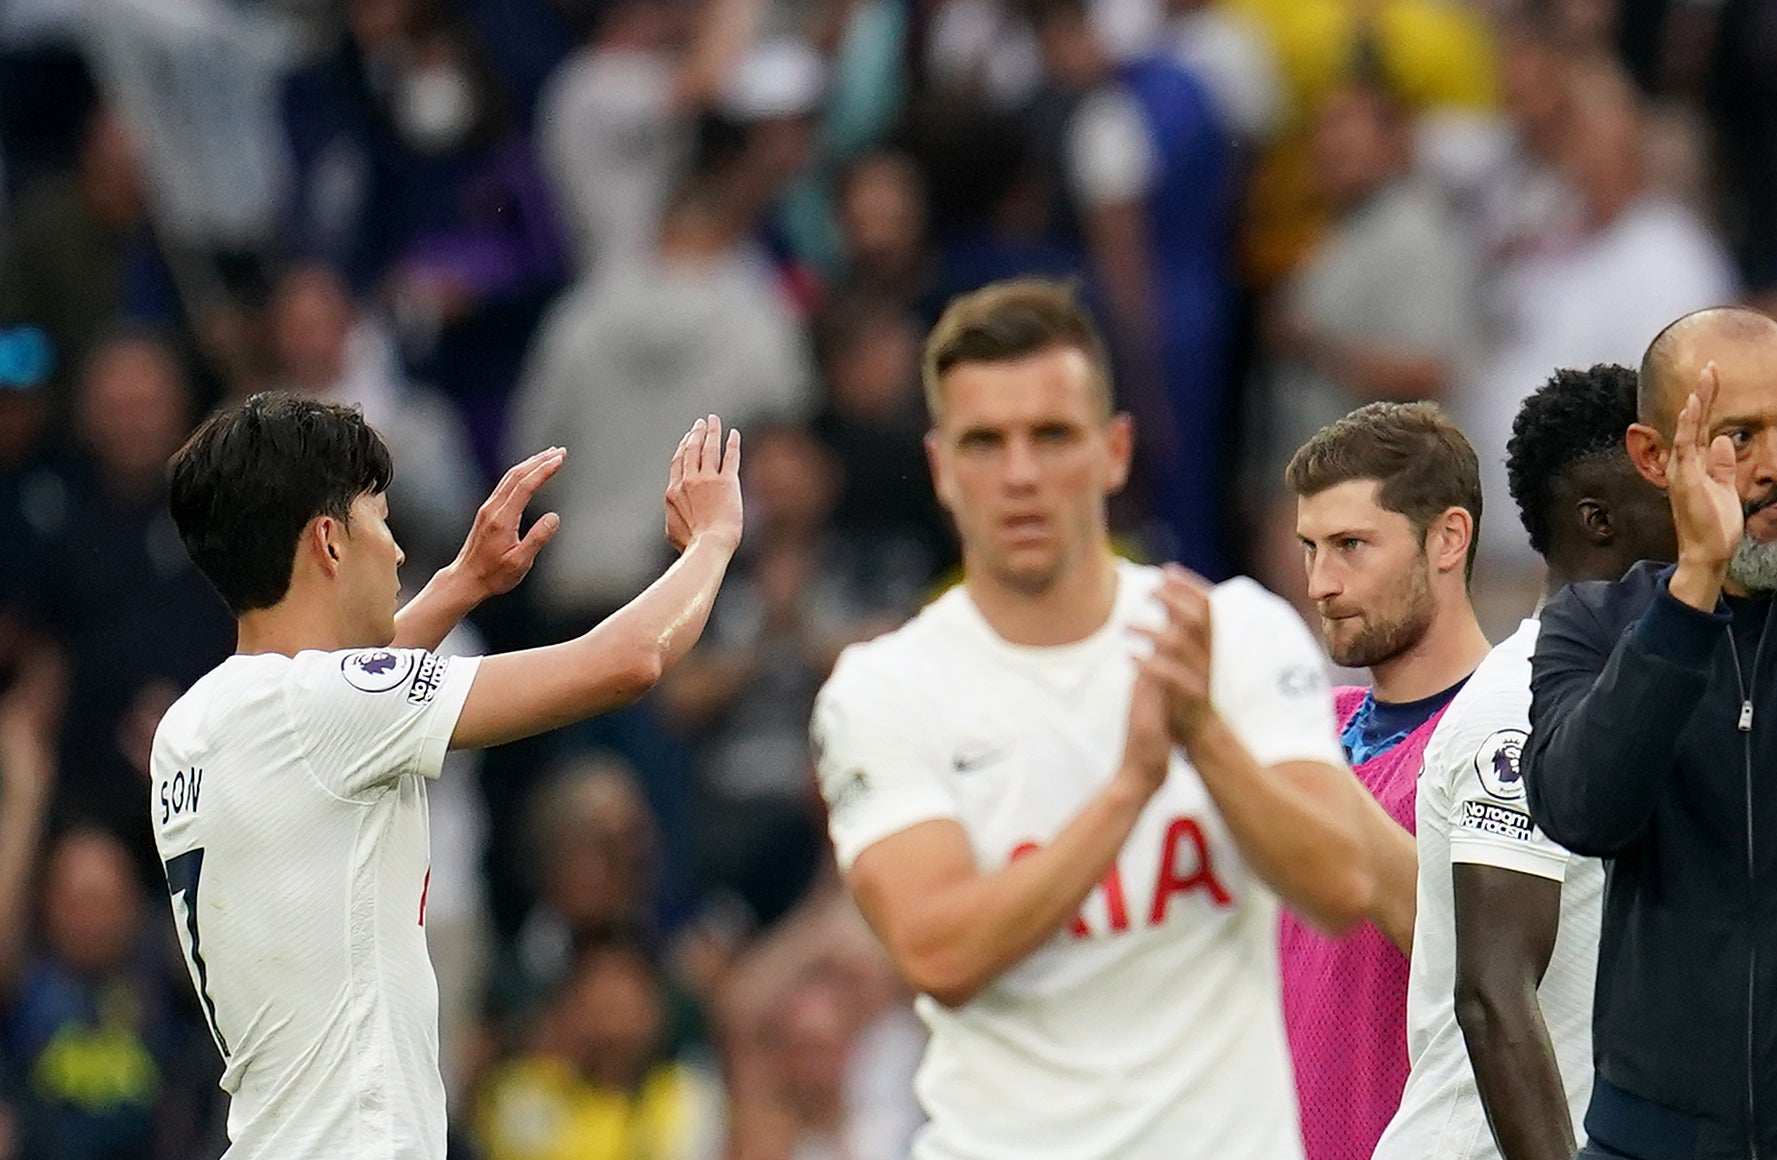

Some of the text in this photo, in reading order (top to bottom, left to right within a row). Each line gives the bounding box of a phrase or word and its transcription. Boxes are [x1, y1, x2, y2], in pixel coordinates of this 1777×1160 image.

[408, 680, 428, 704] No
[161, 767, 202, 825] SON
[1464, 801, 1529, 829] No room
[1480, 818, 1532, 841] racism
[1009, 816, 1234, 938] IA
[165, 846, 230, 1057] 7
